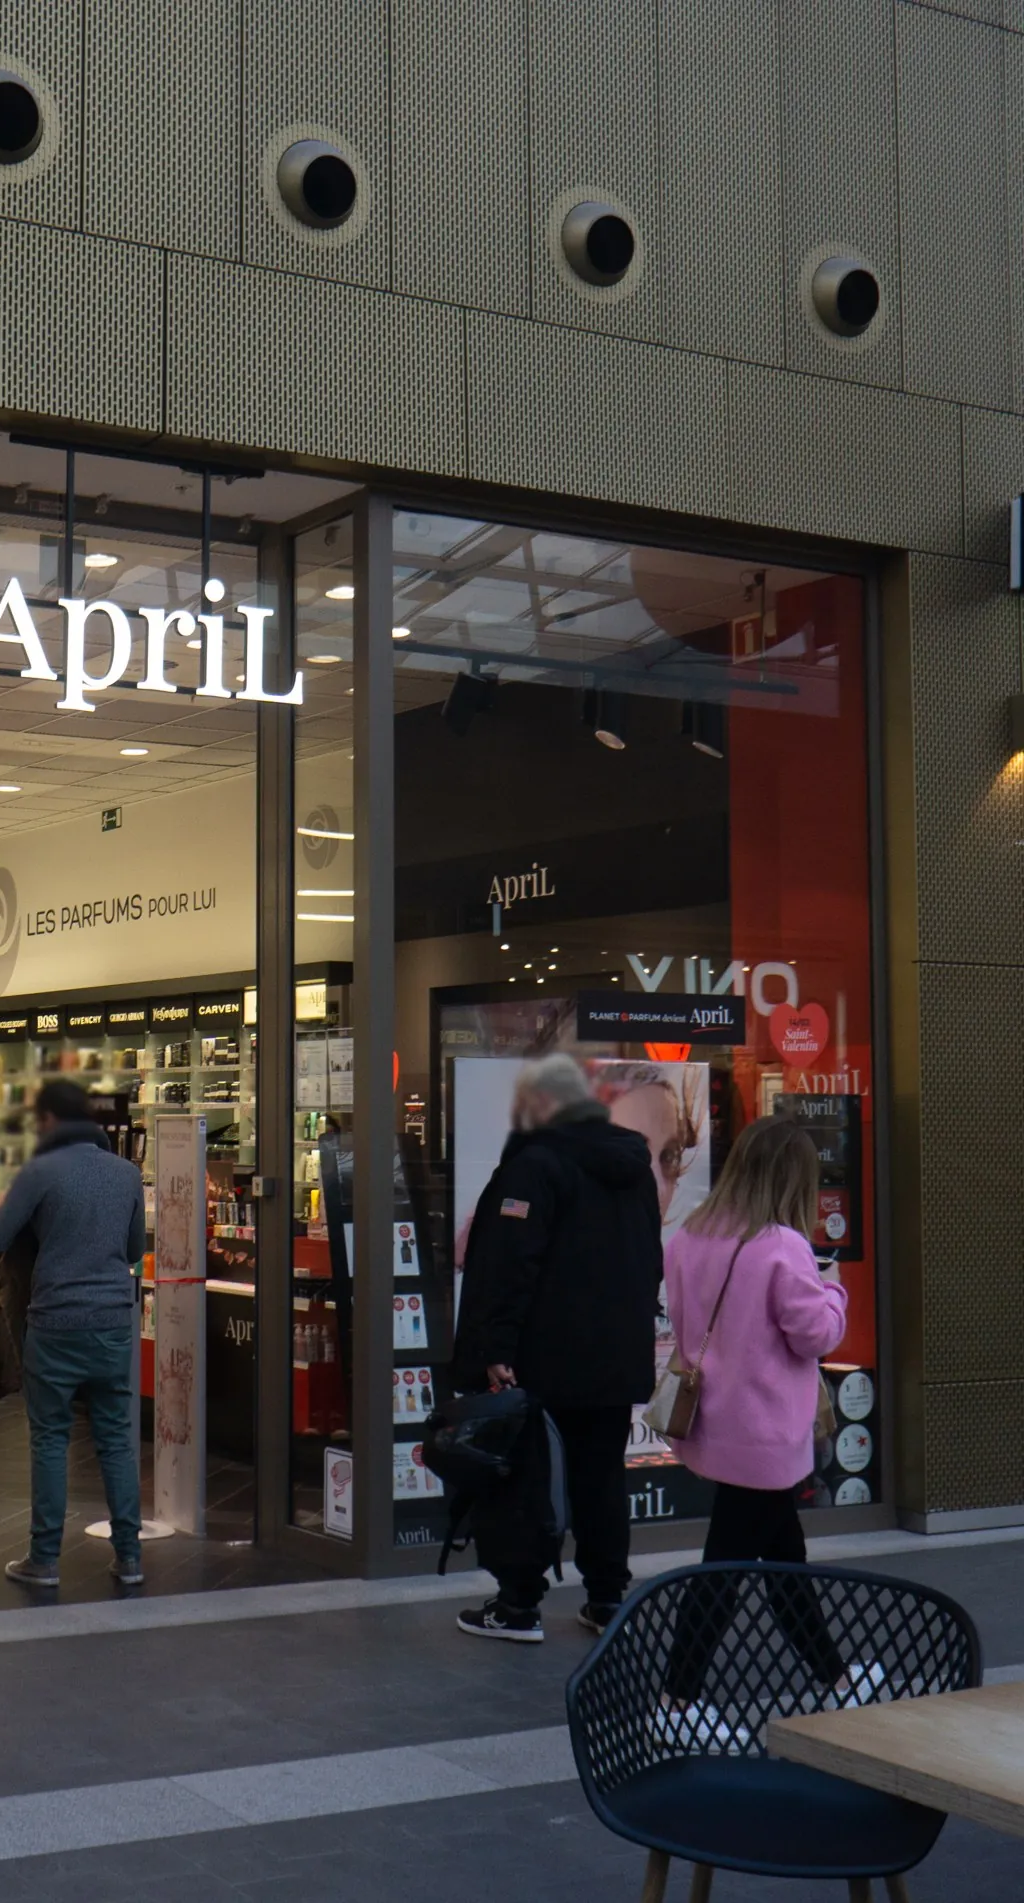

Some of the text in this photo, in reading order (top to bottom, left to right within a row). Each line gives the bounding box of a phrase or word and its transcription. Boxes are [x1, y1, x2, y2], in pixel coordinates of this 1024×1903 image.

[27, 887, 216, 937] LES PARFUMS POUR LUI
[198, 1003, 239, 1015] CARVEN
[589, 1011, 620, 1021] PLANET
[628, 1013, 661, 1022] PARFUM
[37, 1014, 58, 1028] BOSS
[69, 1014, 102, 1026] GIVENCHY
[225, 1315, 254, 1346] Apr
[629, 1421, 664, 1445] Di
[629, 1482, 674, 1520] riL
